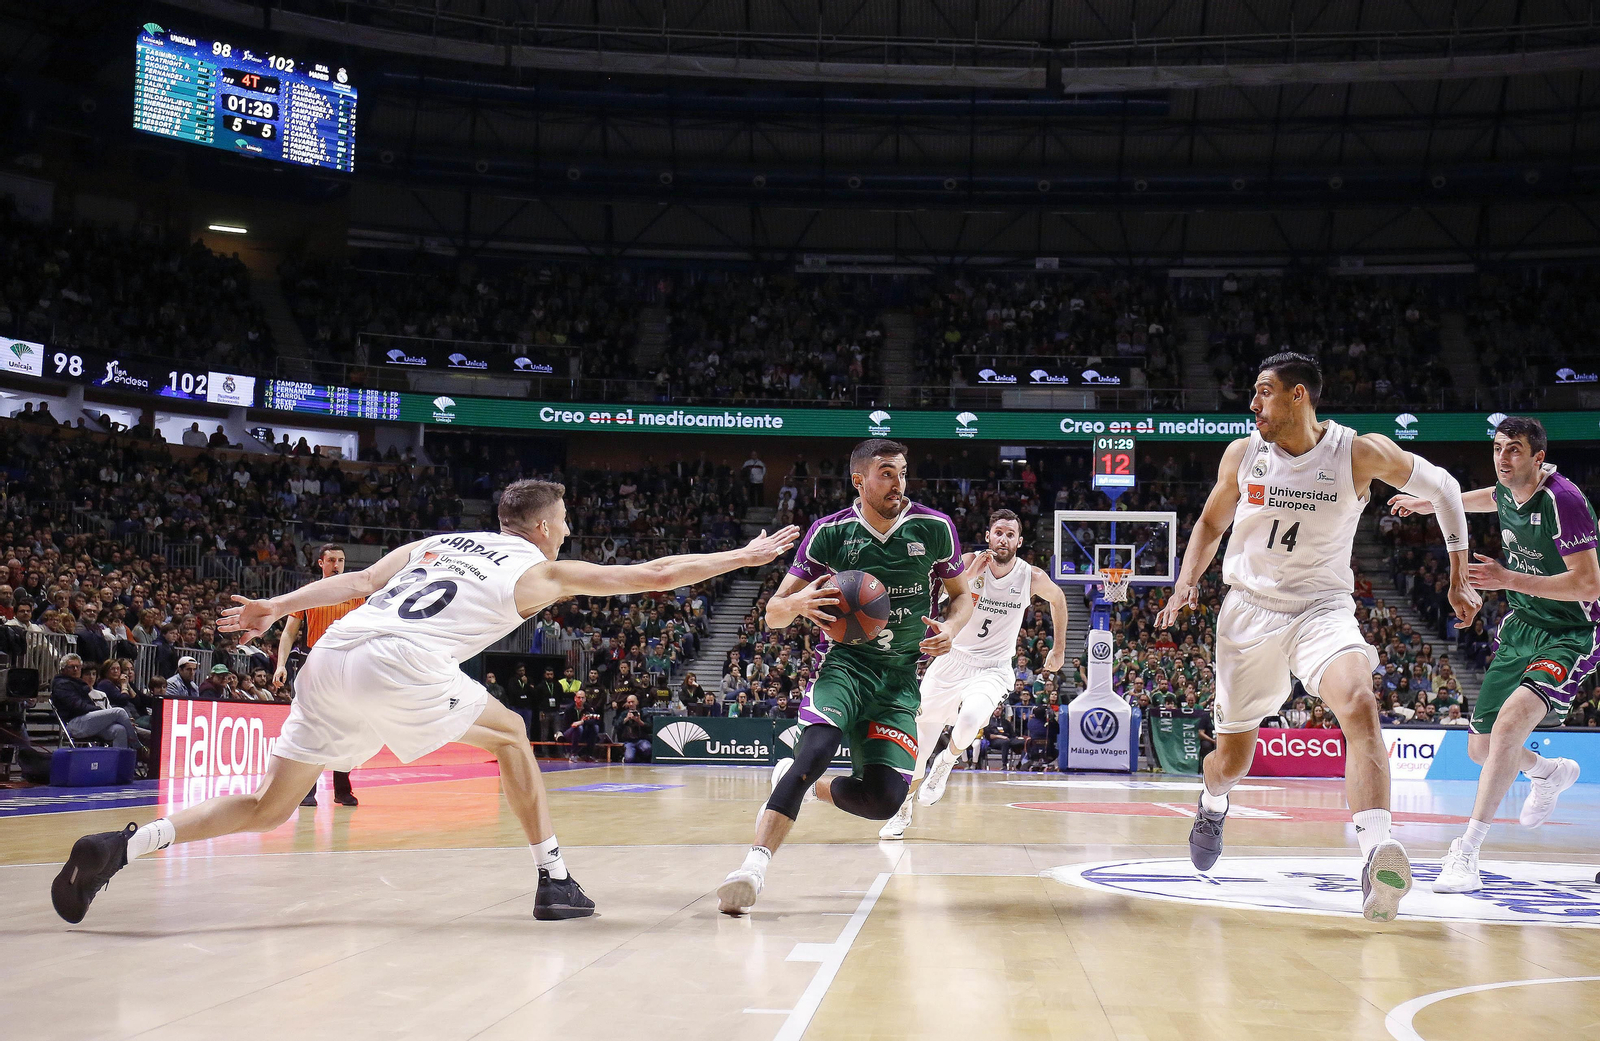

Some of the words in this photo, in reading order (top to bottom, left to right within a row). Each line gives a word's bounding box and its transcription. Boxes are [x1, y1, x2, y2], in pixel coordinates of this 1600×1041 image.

[212, 42, 232, 57] 98
[268, 55, 295, 73] 102
[242, 74, 260, 88] 4T
[228, 96, 273, 118] 01:29
[232, 117, 242, 132] 5
[261, 123, 272, 138] 5
[54, 352, 83, 377] 98
[169, 371, 207, 395] 102
[540, 407, 585, 423] Creo
[589, 411, 611, 424] en
[616, 409, 634, 425] el
[639, 410, 784, 429] medioambiente
[1060, 418, 1105, 434] Creo
[1109, 422, 1132, 433] en
[1136, 418, 1154, 434] el
[1098, 438, 1134, 450] 01:29
[1101, 453, 1130, 474] 12
[1269, 486, 1338, 503] Universidad
[1268, 498, 1316, 512] Europea
[1266, 519, 1300, 552] 14
[369, 567, 458, 620] 20
[977, 603, 1008, 615] Europea
[980, 596, 1021, 609] Universidad
[977, 618, 992, 638] 5
[706, 739, 769, 758] Unicaja
[1071, 747, 1099, 755] Málaga
[1101, 747, 1128, 756] Wagen
